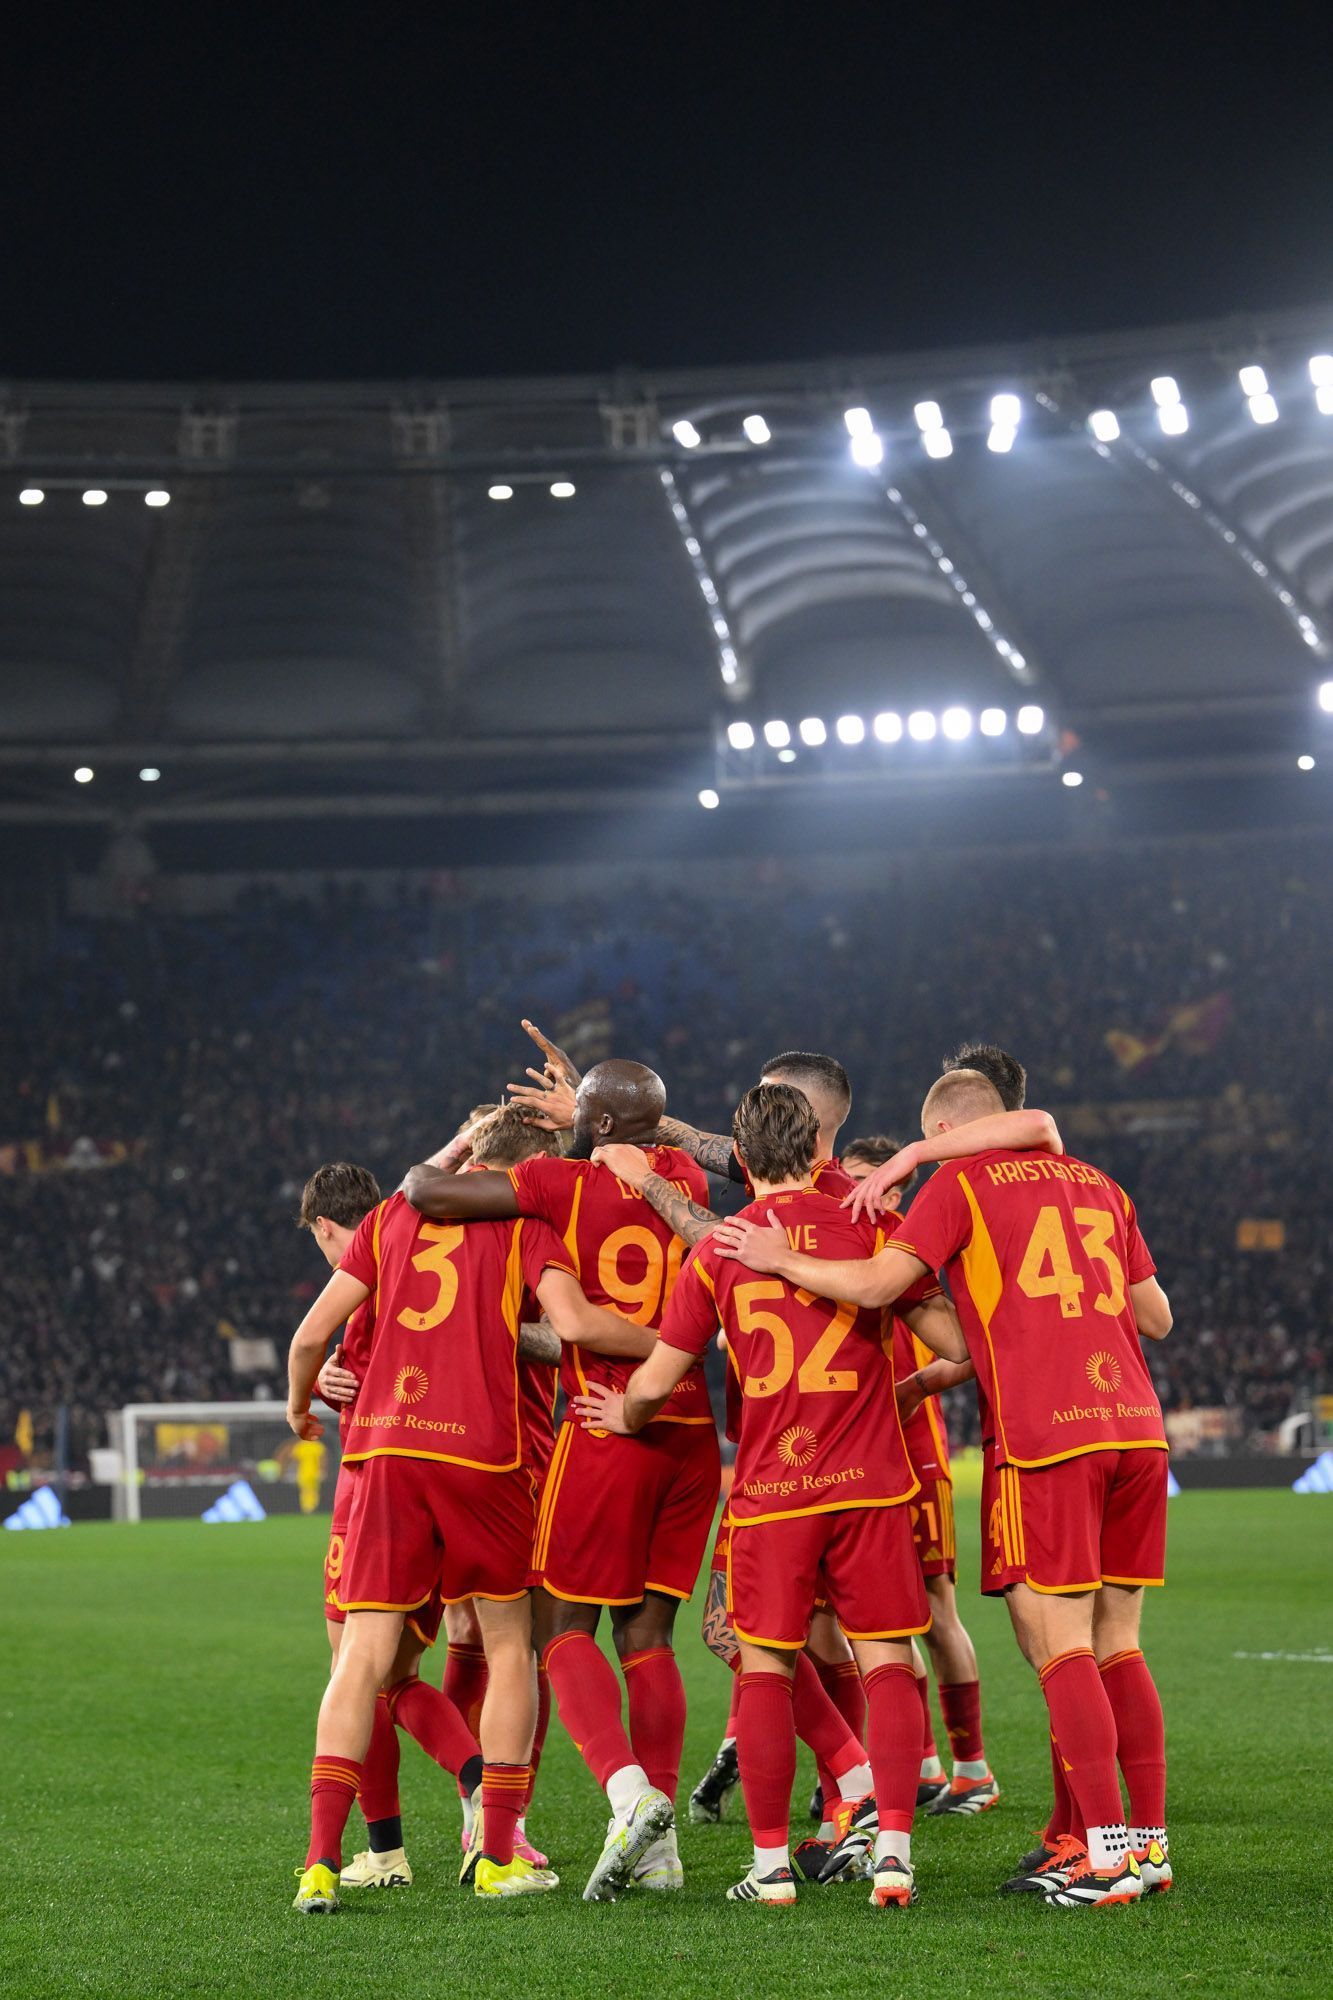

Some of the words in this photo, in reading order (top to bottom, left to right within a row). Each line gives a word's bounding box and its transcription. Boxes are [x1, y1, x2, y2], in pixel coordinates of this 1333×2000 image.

[985, 1159, 1111, 1190] KRISTENSEN
[786, 1224, 818, 1251] VE
[1016, 1206, 1126, 1318] 43
[397, 1225, 464, 1332] 3
[734, 1280, 859, 1398] 52
[352, 1412, 401, 1429] Auberge
[403, 1413, 466, 1435] Resorts
[1051, 1405, 1113, 1424] Auberge
[1116, 1403, 1161, 1418] Resorts
[743, 1480, 799, 1497] Auberge
[801, 1467, 865, 1490] Resorts
